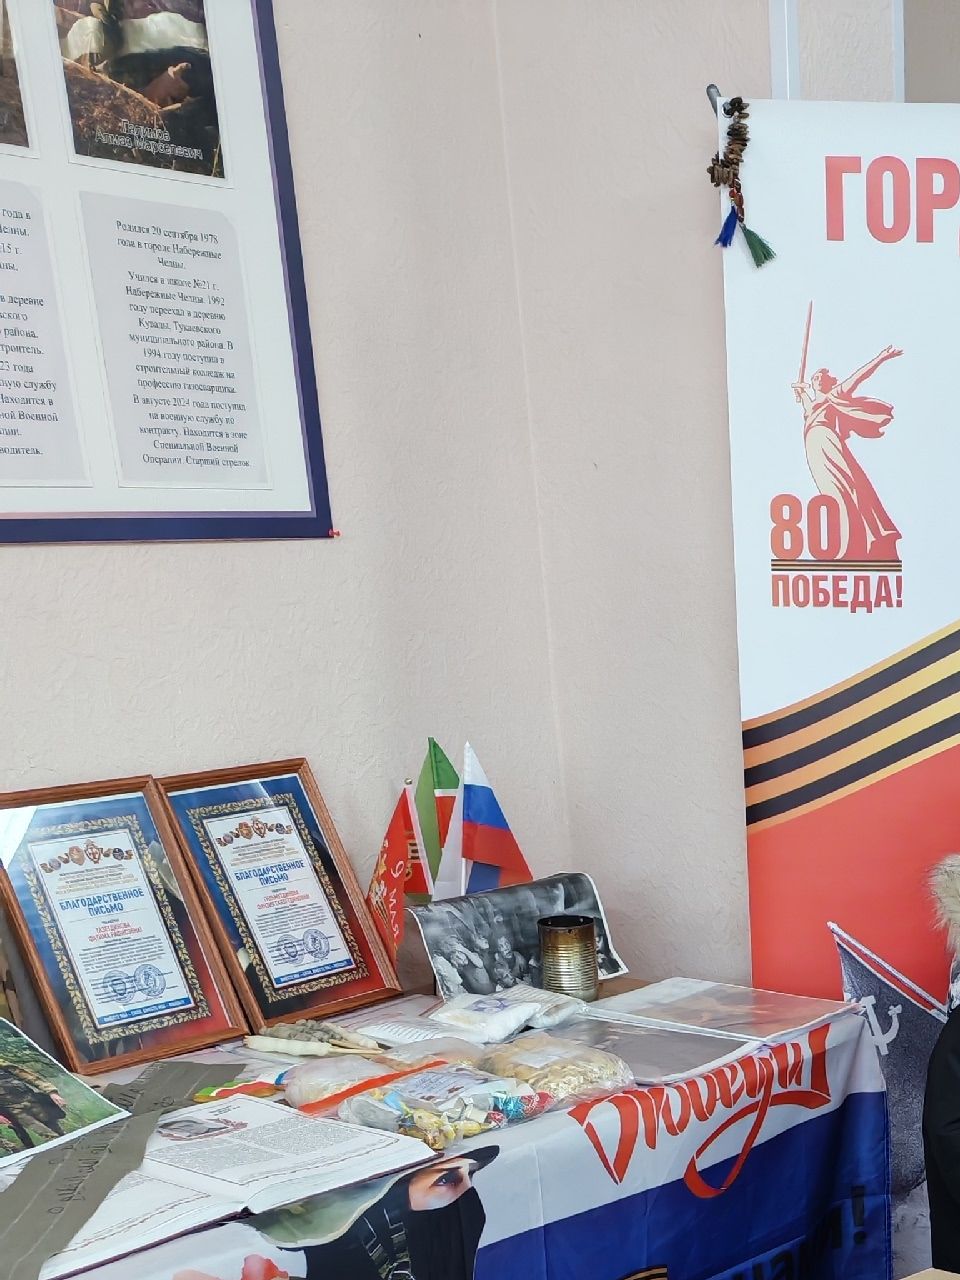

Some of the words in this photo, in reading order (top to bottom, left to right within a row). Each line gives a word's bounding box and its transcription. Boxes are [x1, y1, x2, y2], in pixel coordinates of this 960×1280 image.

[116, 220, 150, 233] Родился
[151, 226, 161, 235] 20
[164, 231, 198, 242] сентября
[201, 233, 219, 244] 1978
[117, 238, 135, 247] года
[144, 243, 171, 253] городе
[172, 244, 222, 259] Набережные
[128, 271, 158, 283] Учился
[167, 279, 191, 288] школе
[8, 296, 44, 307] деревне
[126, 286, 176, 300] Набережные
[208, 295, 225, 306] 1992
[129, 303, 148, 314] году
[150, 306, 184, 317] переехал
[193, 312, 226, 321] деревню
[173, 320, 221, 334] Тукаевского
[129, 333, 195, 347] муниципального
[227, 341, 234, 350] В
[143, 347, 161, 358] 1994
[164, 352, 181, 362] году
[183, 353, 218, 364] поступил
[13, 364, 33, 373] года
[136, 364, 190, 375] строительный
[192, 369, 224, 379] колледж
[24, 380, 57, 392] службу
[137, 378, 181, 390] профессию
[132, 394, 139, 403] В
[142, 397, 171, 408] августе
[172, 398, 190, 406] 2024
[192, 401, 209, 409] года
[211, 402, 246, 412] поступил
[19, 410, 58, 422] Военной
[160, 413, 194, 423] военную
[196, 414, 223, 425] службу
[183, 427, 223, 439] Находится
[153, 440, 205, 452] Специальной
[206, 442, 239, 453] Военной
[186, 456, 220, 467] Старший
[769, 493, 841, 561] 80
[770, 573, 903, 614] ПОБЕДА!
[234, 859, 306, 881] БЛАГОДАРСТВЕННОЕ
[259, 872, 289, 887] ПИСЬМО
[59, 887, 145, 911] БЛАГОДАРСТВЕННОЕ
[88, 902, 124, 917] ПИСЬМО
